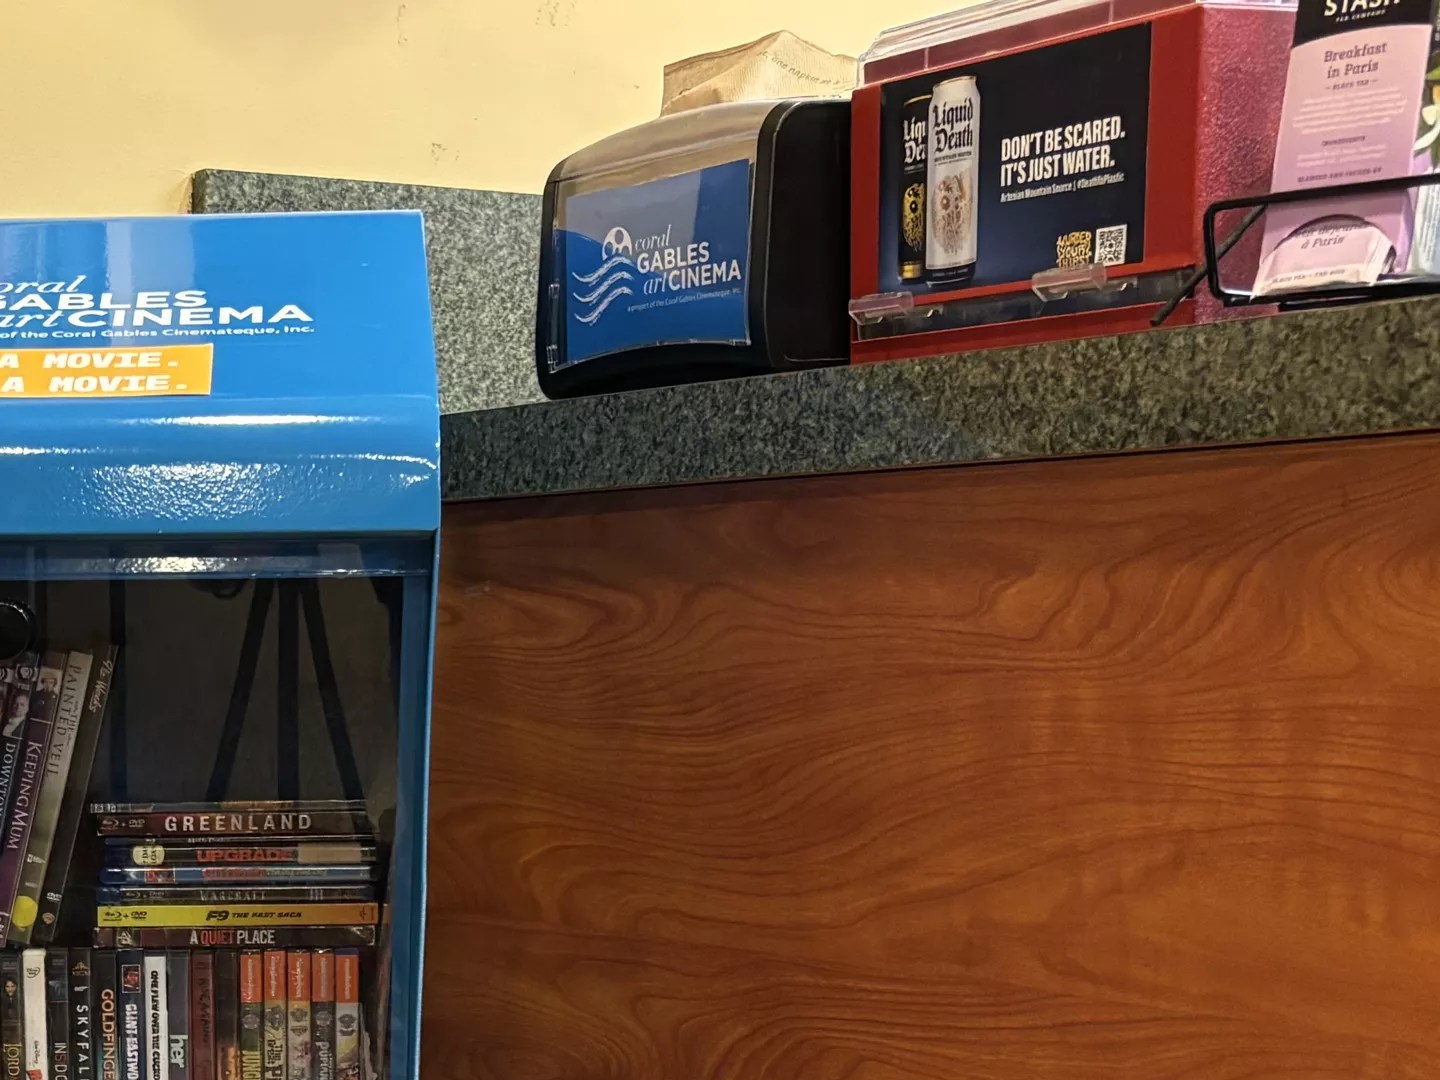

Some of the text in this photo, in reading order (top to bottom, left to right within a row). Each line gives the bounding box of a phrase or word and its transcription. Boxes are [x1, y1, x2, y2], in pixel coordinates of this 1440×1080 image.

[1324, 42, 1387, 63] Breakfast
[1327, 60, 1379, 79] in Paris
[932, 97, 974, 129] Liquid
[934, 126, 974, 153] Death
[1001, 116, 1126, 161] DON'T BE SCARED.
[1000, 145, 1115, 187] IT'S JUST WATER.
[635, 224, 672, 250] coral
[1312, 235, 1346, 249] Paris
[636, 241, 710, 274] GABLES
[0, 330, 19, 340] of
[21, 331, 49, 339] the
[52, 329, 97, 339] Coral
[101, 328, 157, 338] Gables
[284, 326, 315, 334] Inc.
[42, 351, 179, 369] MOVIE.
[0, 376, 25, 393] A
[48, 375, 188, 393] MOVIE.
[46, 664, 83, 778] PAINTED VEIL
[6, 741, 43, 850] KEEPING MUM
[165, 814, 312, 832] GREENLAND
[197, 849, 294, 863] UPGRADE
[206, 910, 230, 921] F9
[190, 929, 275, 945] A QUIET PLACE
[151, 970, 160, 988] ONE
[151, 989, 160, 1011] FLEW
[125, 1003, 137, 1034] CLINT
[152, 1012, 160, 1034] OVER
[152, 1035, 160, 1050] THE
[170, 1034, 188, 1068] her
[3, 1043, 22, 1076] LORD
